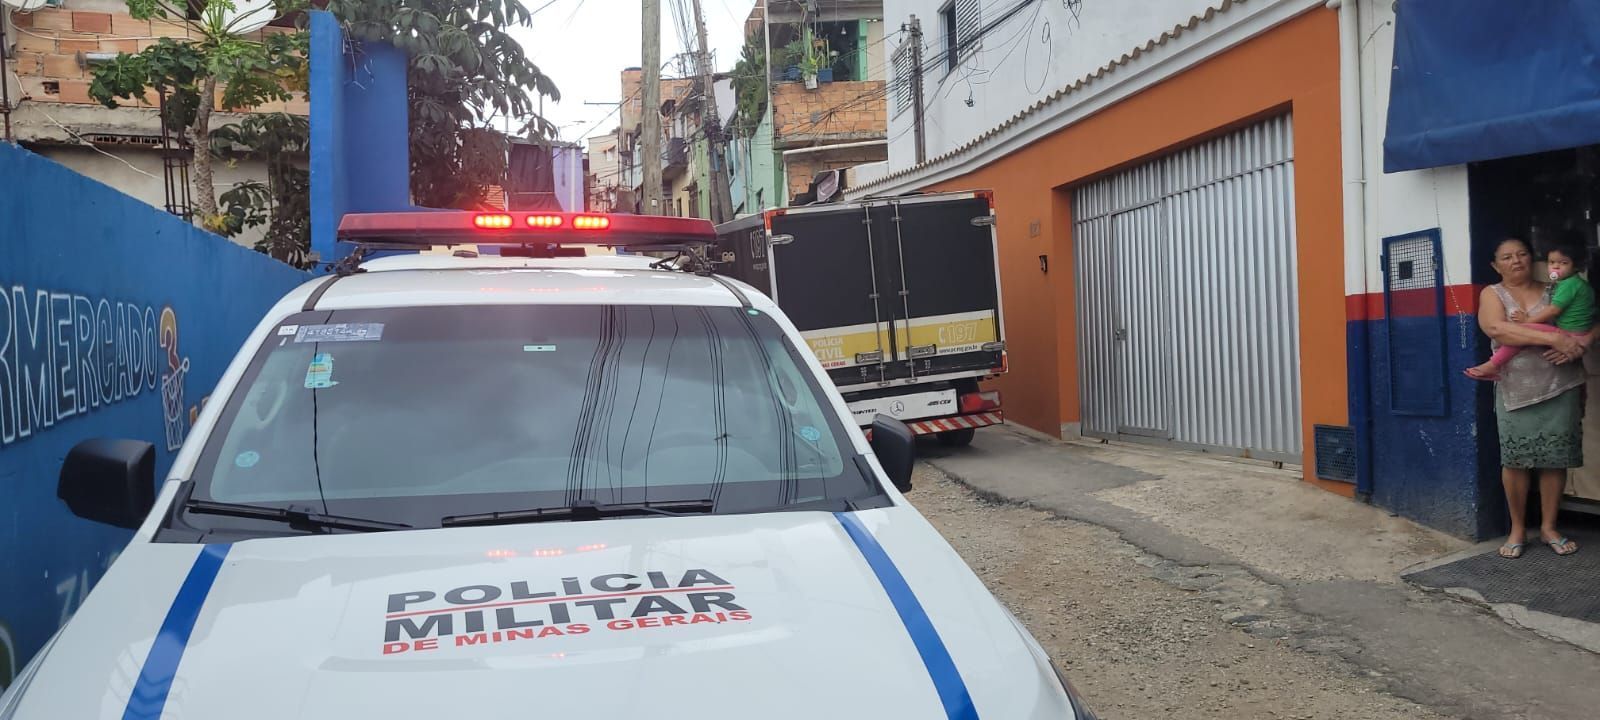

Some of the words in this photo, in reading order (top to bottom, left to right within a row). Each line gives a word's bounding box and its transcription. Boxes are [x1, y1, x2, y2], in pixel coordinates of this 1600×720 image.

[815, 347, 846, 360] CIVIL
[383, 639, 439, 655] DE
[455, 623, 591, 647] MINAS
[607, 610, 753, 633] GERAIS
[384, 591, 748, 643] MILITAR
